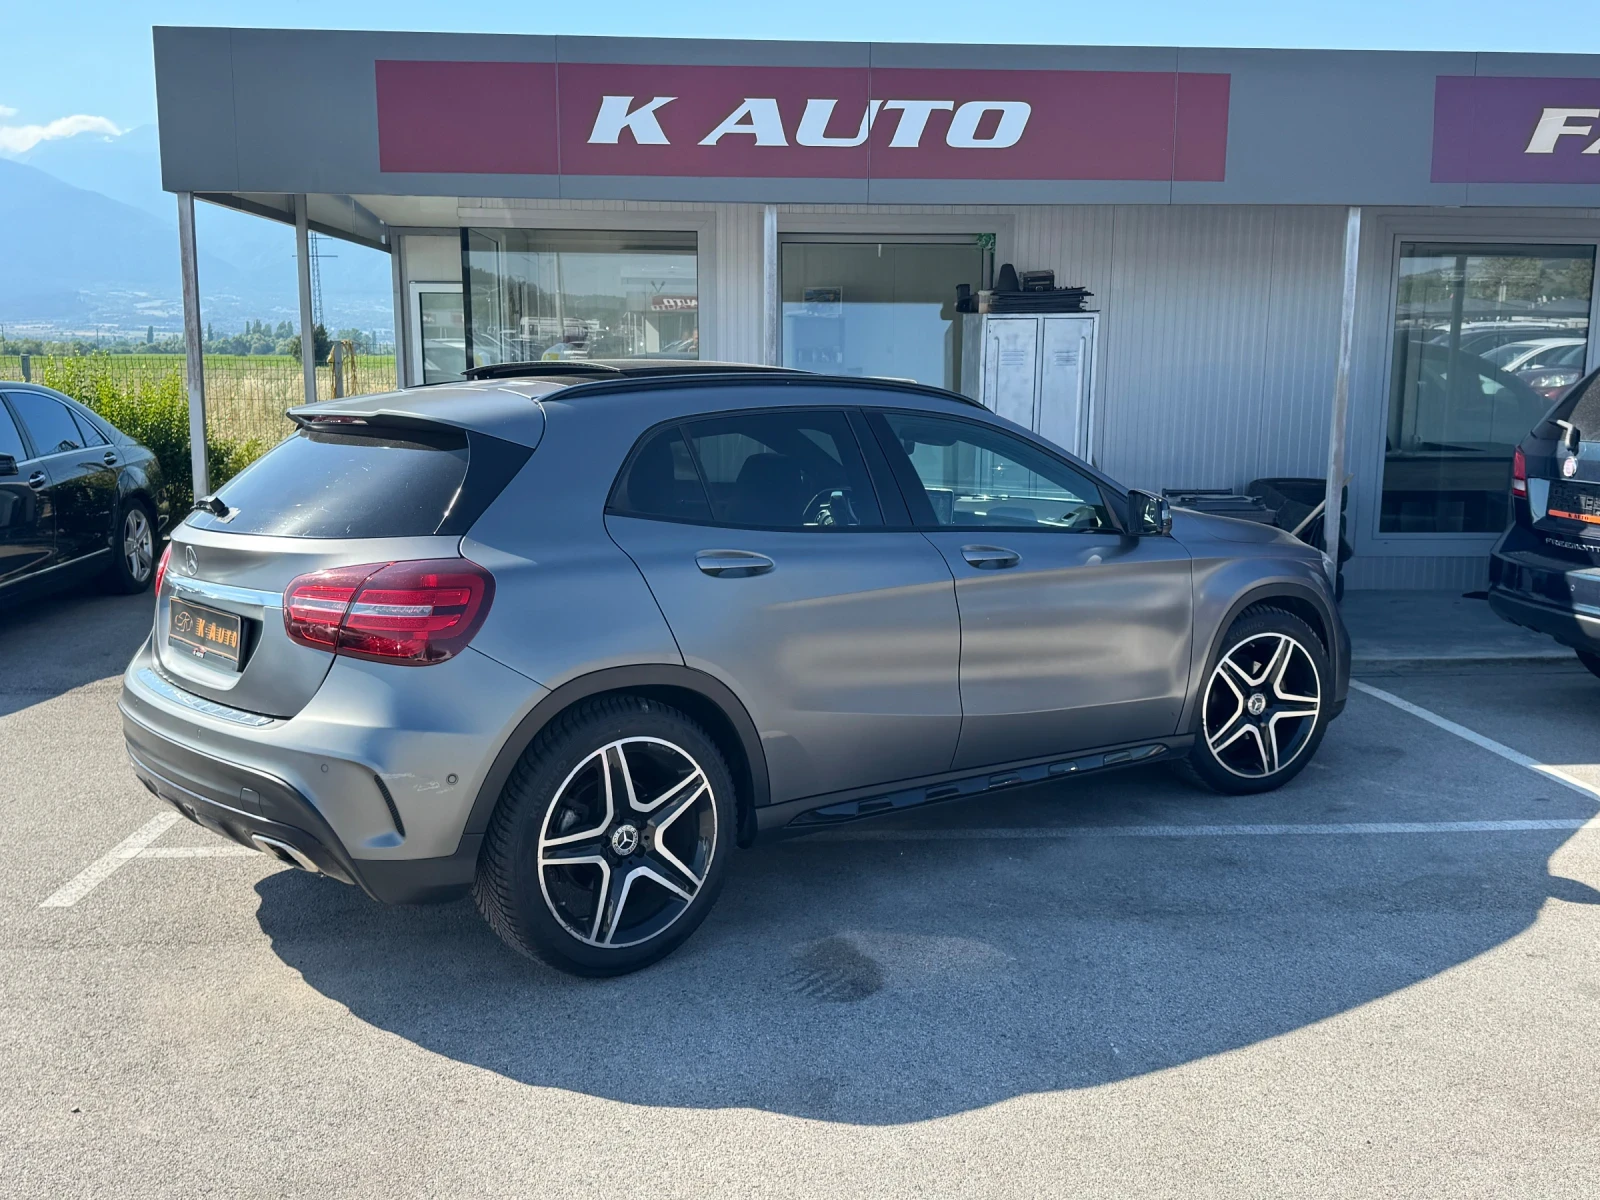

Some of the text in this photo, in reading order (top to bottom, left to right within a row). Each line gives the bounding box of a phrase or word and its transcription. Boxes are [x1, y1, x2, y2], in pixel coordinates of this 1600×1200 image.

[587, 95, 1031, 148] K AUTO
[195, 617, 238, 649] K AUTO
